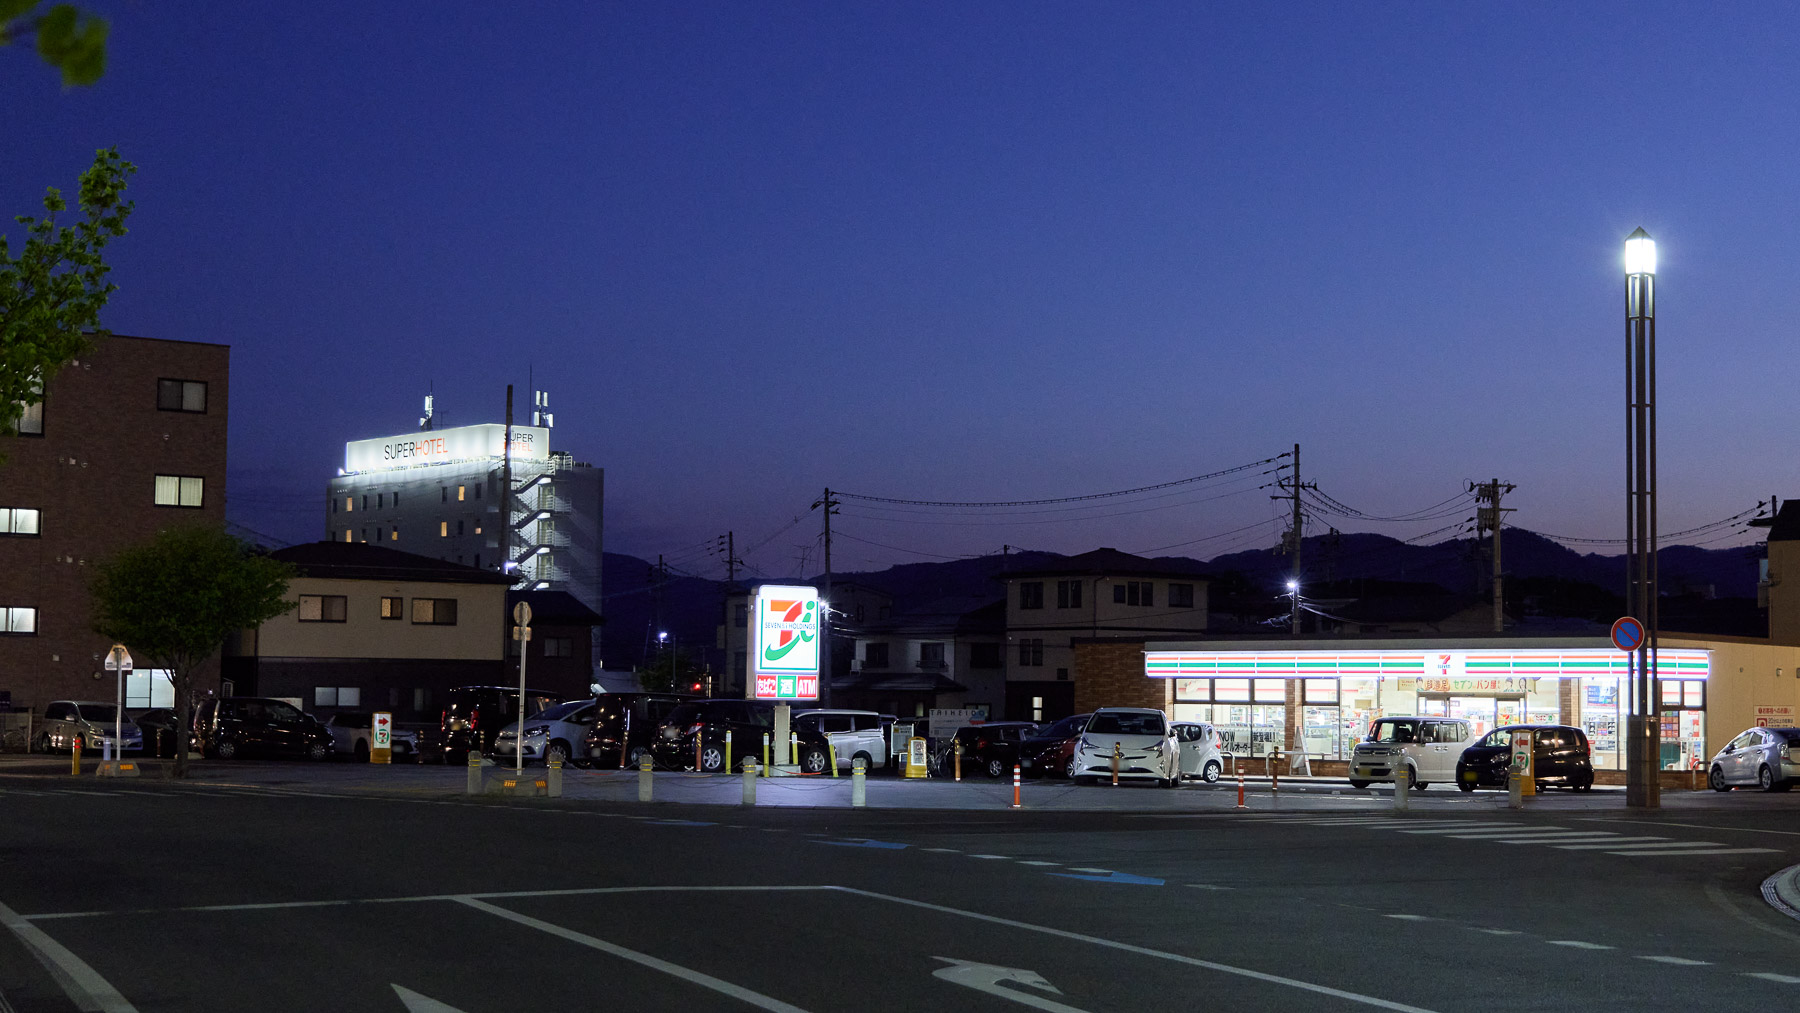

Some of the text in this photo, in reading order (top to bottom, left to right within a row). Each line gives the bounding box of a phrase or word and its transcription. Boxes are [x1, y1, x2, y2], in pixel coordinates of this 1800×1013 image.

[504, 432, 534, 442] UPER
[788, 622, 816, 630] HOLDINGS
[757, 678, 816, 695] たばこ 酒 ATM
